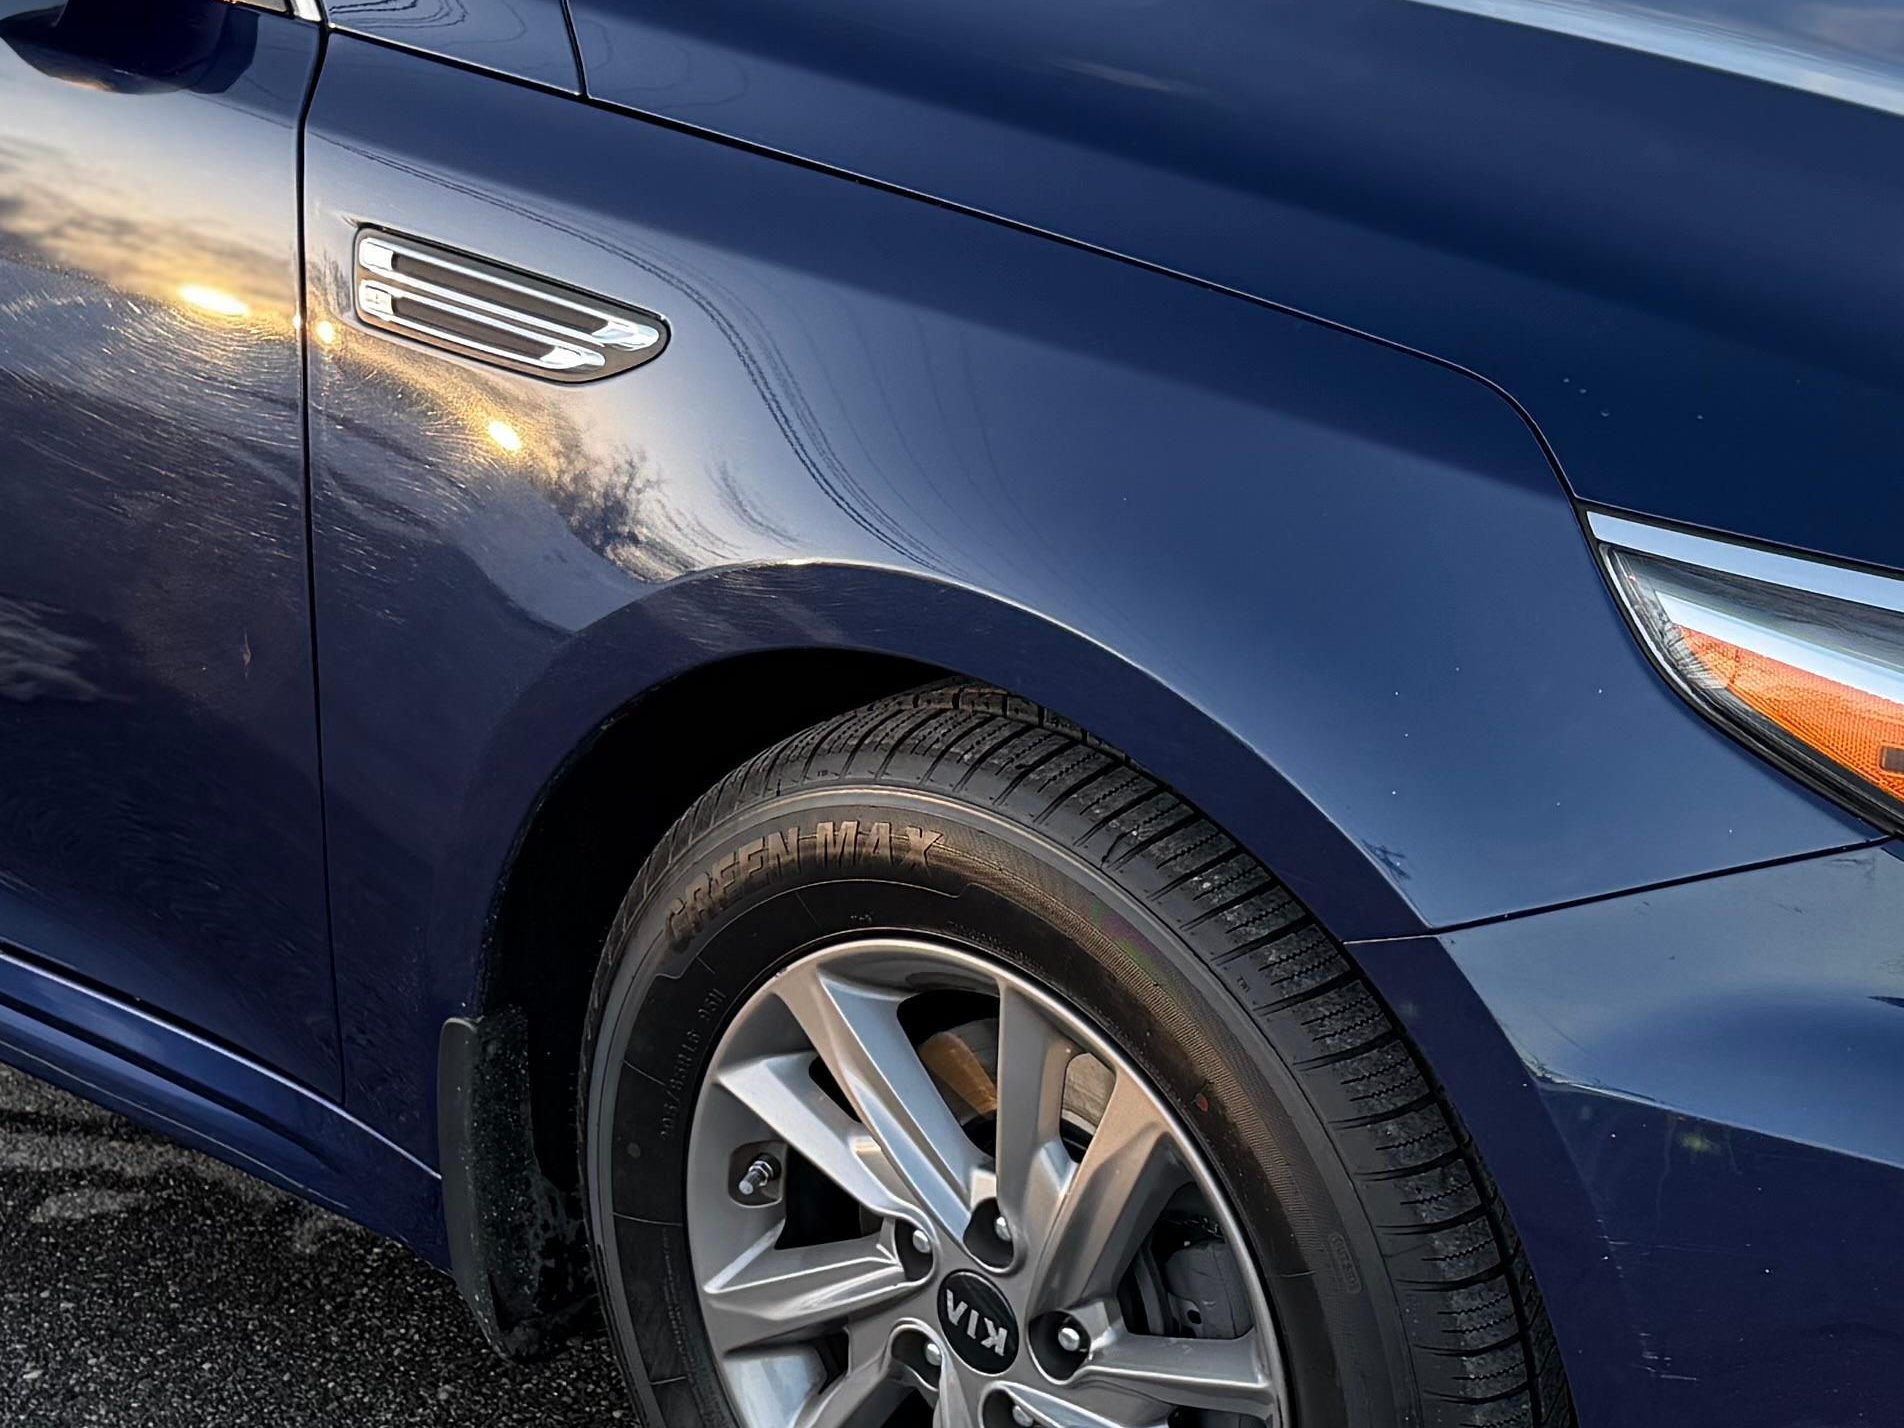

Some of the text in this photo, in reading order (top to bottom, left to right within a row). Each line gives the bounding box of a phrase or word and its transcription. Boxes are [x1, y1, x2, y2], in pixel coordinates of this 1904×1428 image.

[663, 820, 942, 951] GREEN MAX
[946, 1288, 1008, 1357] KIA
